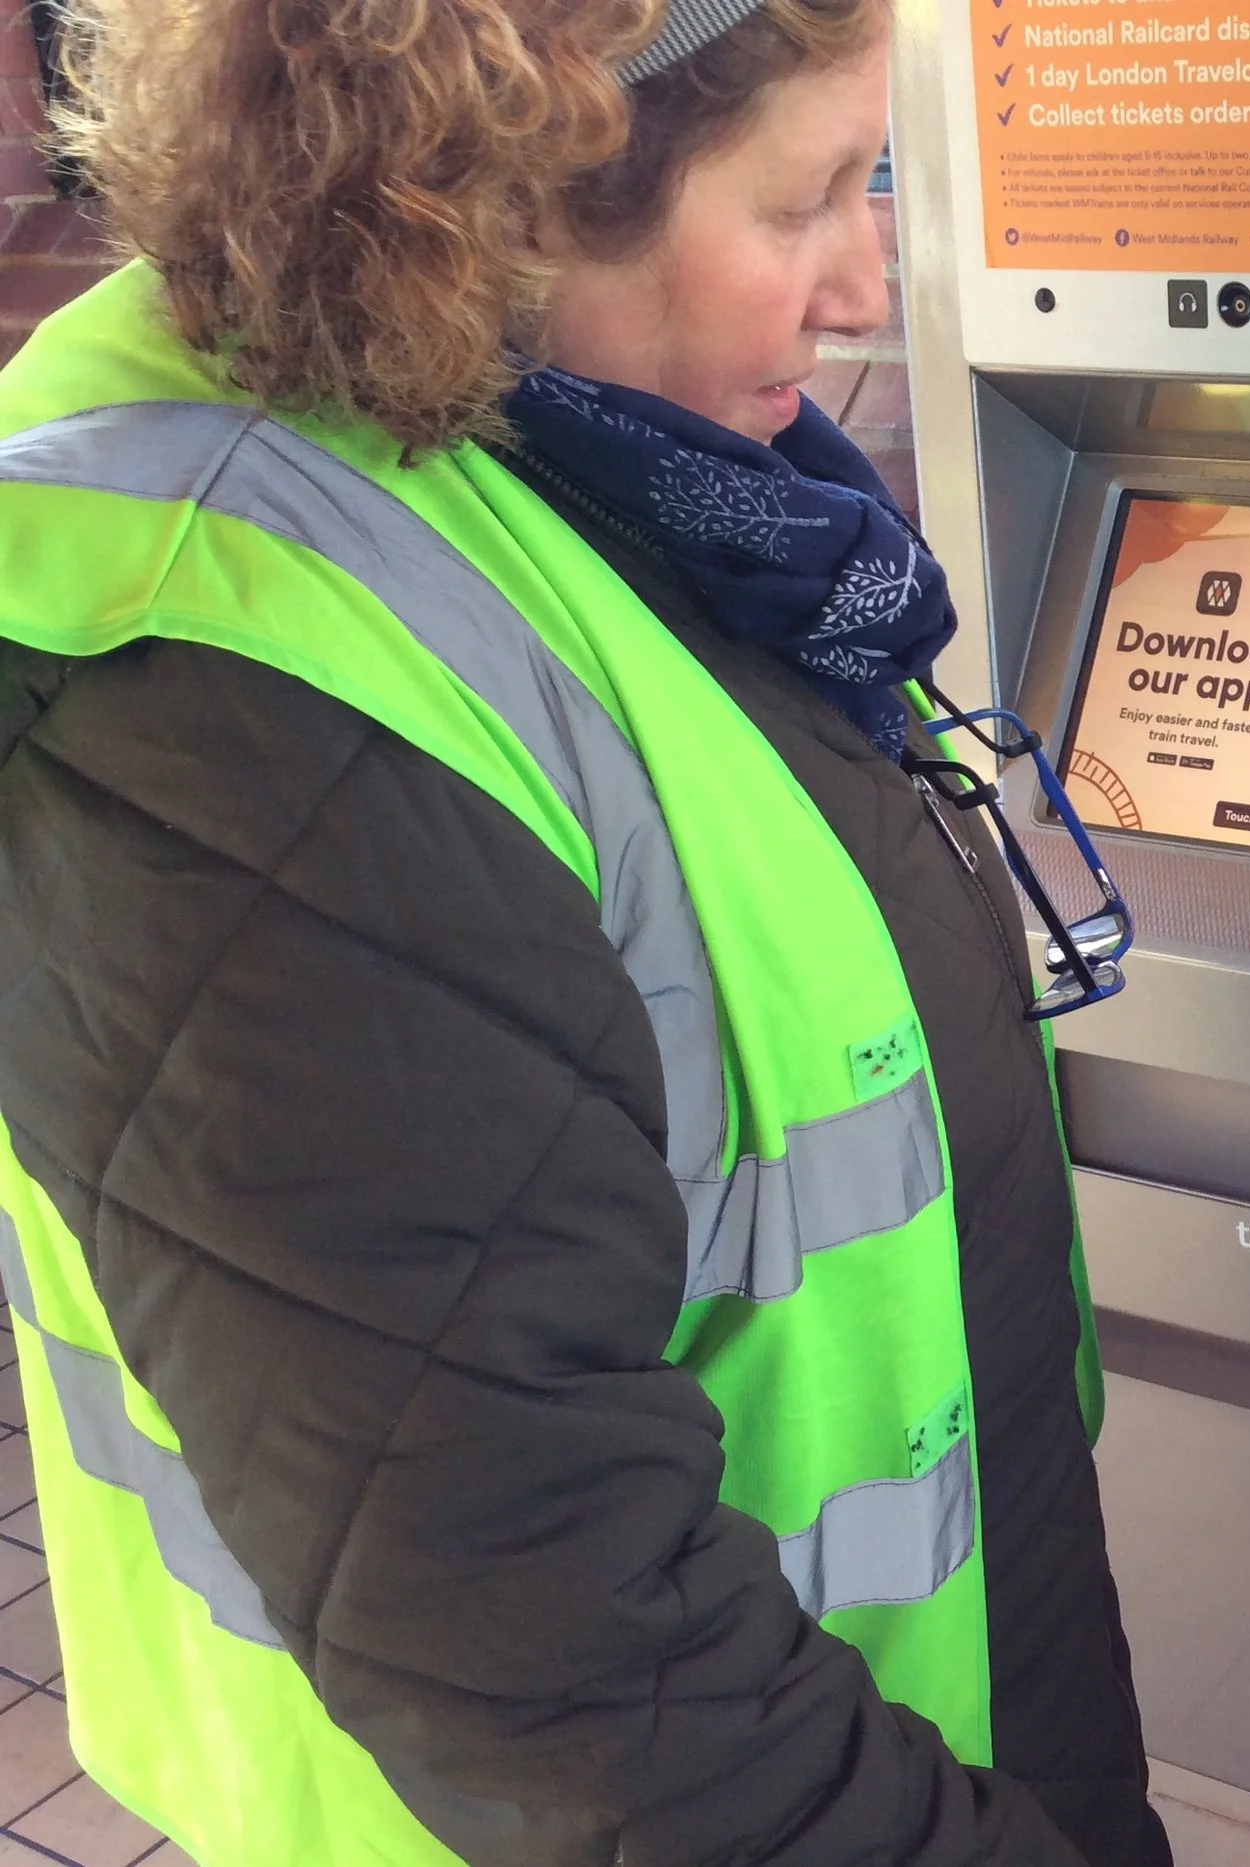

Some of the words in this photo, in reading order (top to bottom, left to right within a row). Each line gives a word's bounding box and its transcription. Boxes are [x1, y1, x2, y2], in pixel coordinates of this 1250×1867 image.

[1023, 20, 1114, 48] National
[1120, 17, 1211, 45] Railcard
[1025, 63, 1036, 88] 1
[1040, 63, 1080, 92] day
[1086, 60, 1167, 86] London
[1028, 103, 1105, 127] Collect
[1110, 99, 1184, 125] tickets
[1075, 151, 1085, 161] to
[1086, 151, 1120, 161] children
[1121, 151, 1143, 162] aged
[1205, 150, 1218, 161] Up
[1219, 149, 1230, 159] to
[1231, 149, 1249, 159] two
[1057, 167, 1084, 178] please
[1085, 166, 1099, 176] ask
[1101, 166, 1110, 176] at
[1111, 166, 1126, 176] the
[1126, 166, 1150, 175] ticket
[1151, 166, 1178, 175] office
[1178, 167, 1188, 175] or
[1190, 165, 1206, 175] talk
[1207, 165, 1217, 175] to
[1218, 166, 1234, 174] our
[1092, 182, 1123, 194] subject
[1124, 182, 1134, 192] to
[1134, 182, 1149, 192] the
[1182, 182, 1219, 191] National
[1220, 182, 1237, 191] Rail
[1131, 198, 1149, 209] only
[1149, 198, 1171, 207] valid
[1171, 199, 1184, 207] on
[1185, 198, 1221, 207] services
[1132, 233, 1156, 243] West
[1157, 233, 1201, 244] Midlands
[1202, 233, 1239, 246] Railway
[1128, 668, 1189, 695] our
[1119, 707, 1153, 725] Enjoy
[1155, 712, 1194, 728] easier
[1195, 718, 1220, 730] and
[1148, 729, 1178, 743] train
[1180, 735, 1220, 749] travel.
